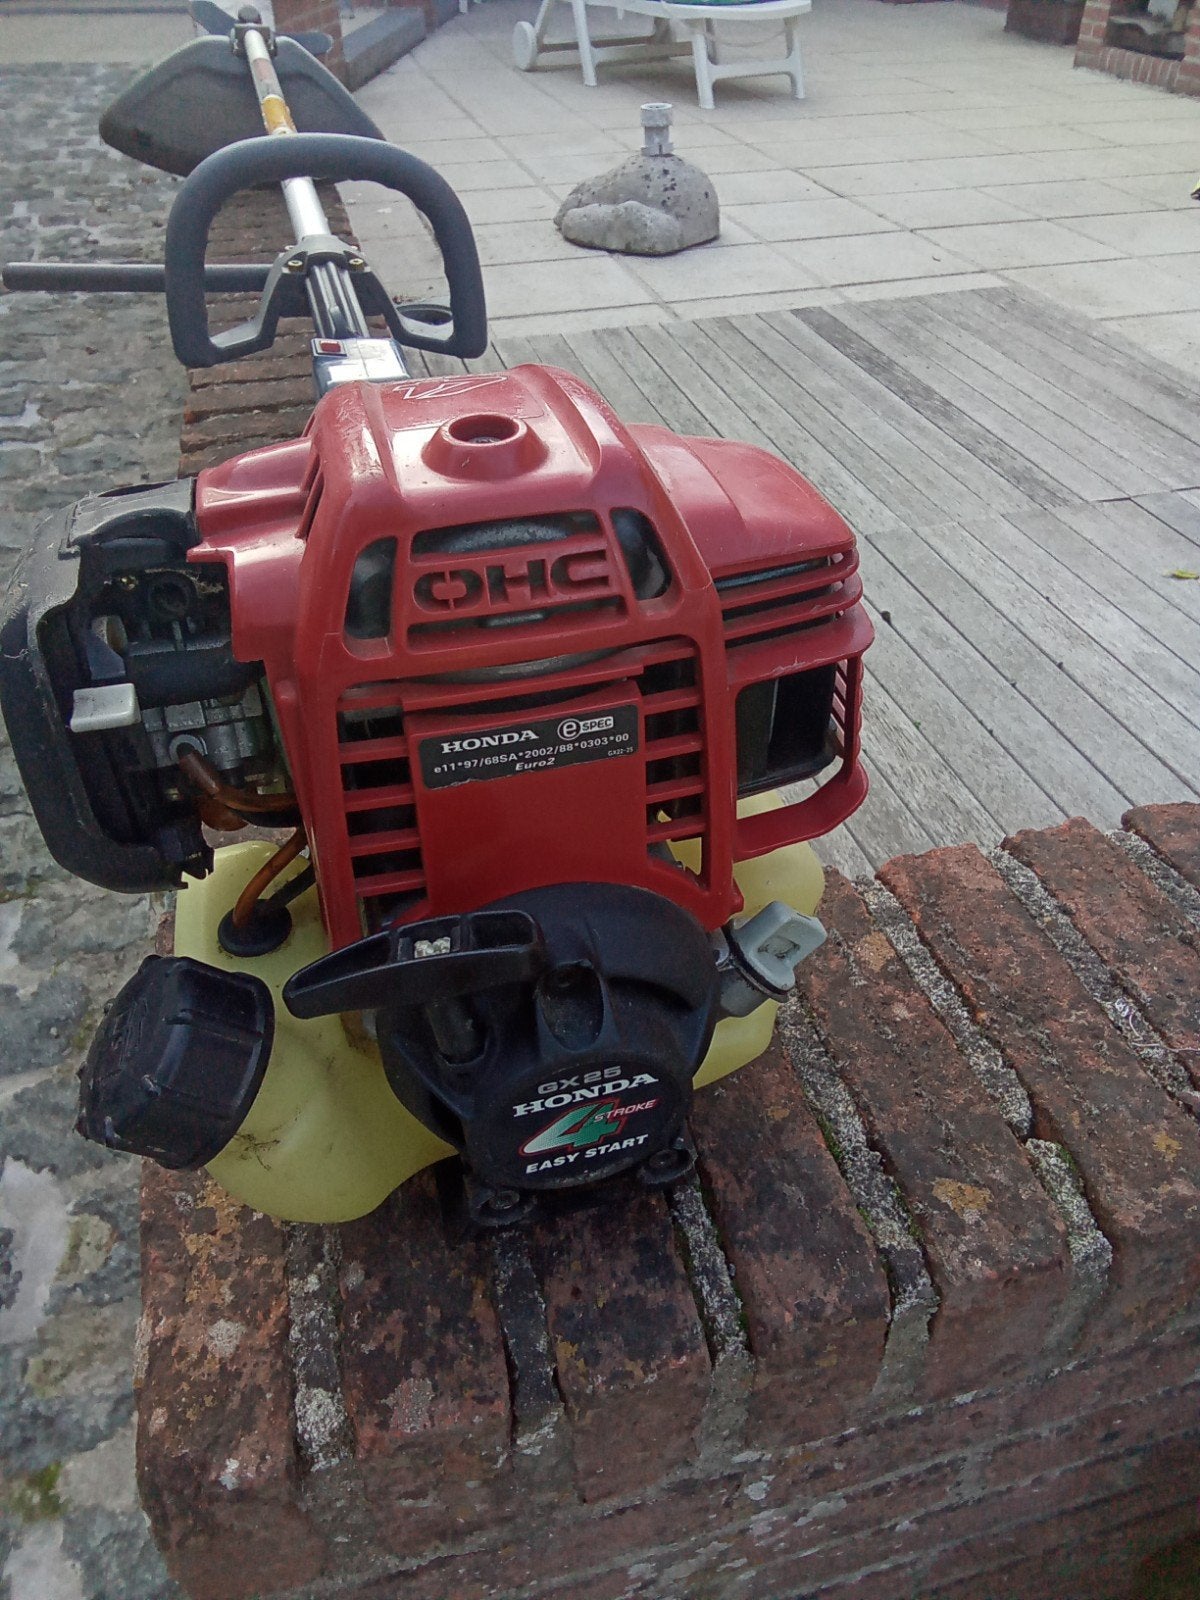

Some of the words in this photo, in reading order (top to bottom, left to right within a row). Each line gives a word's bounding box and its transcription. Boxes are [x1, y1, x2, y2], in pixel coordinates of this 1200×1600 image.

[413, 548, 611, 615] OHC
[440, 729, 540, 754] HONDA
[582, 718, 613, 732] SPEC
[515, 757, 556, 772] Euro2
[512, 1072, 660, 1118] HONDA
[520, 1100, 627, 1156] 4
[594, 1099, 657, 1124] STROKE
[525, 1151, 581, 1175] EASY
[584, 1133, 649, 1159] START
